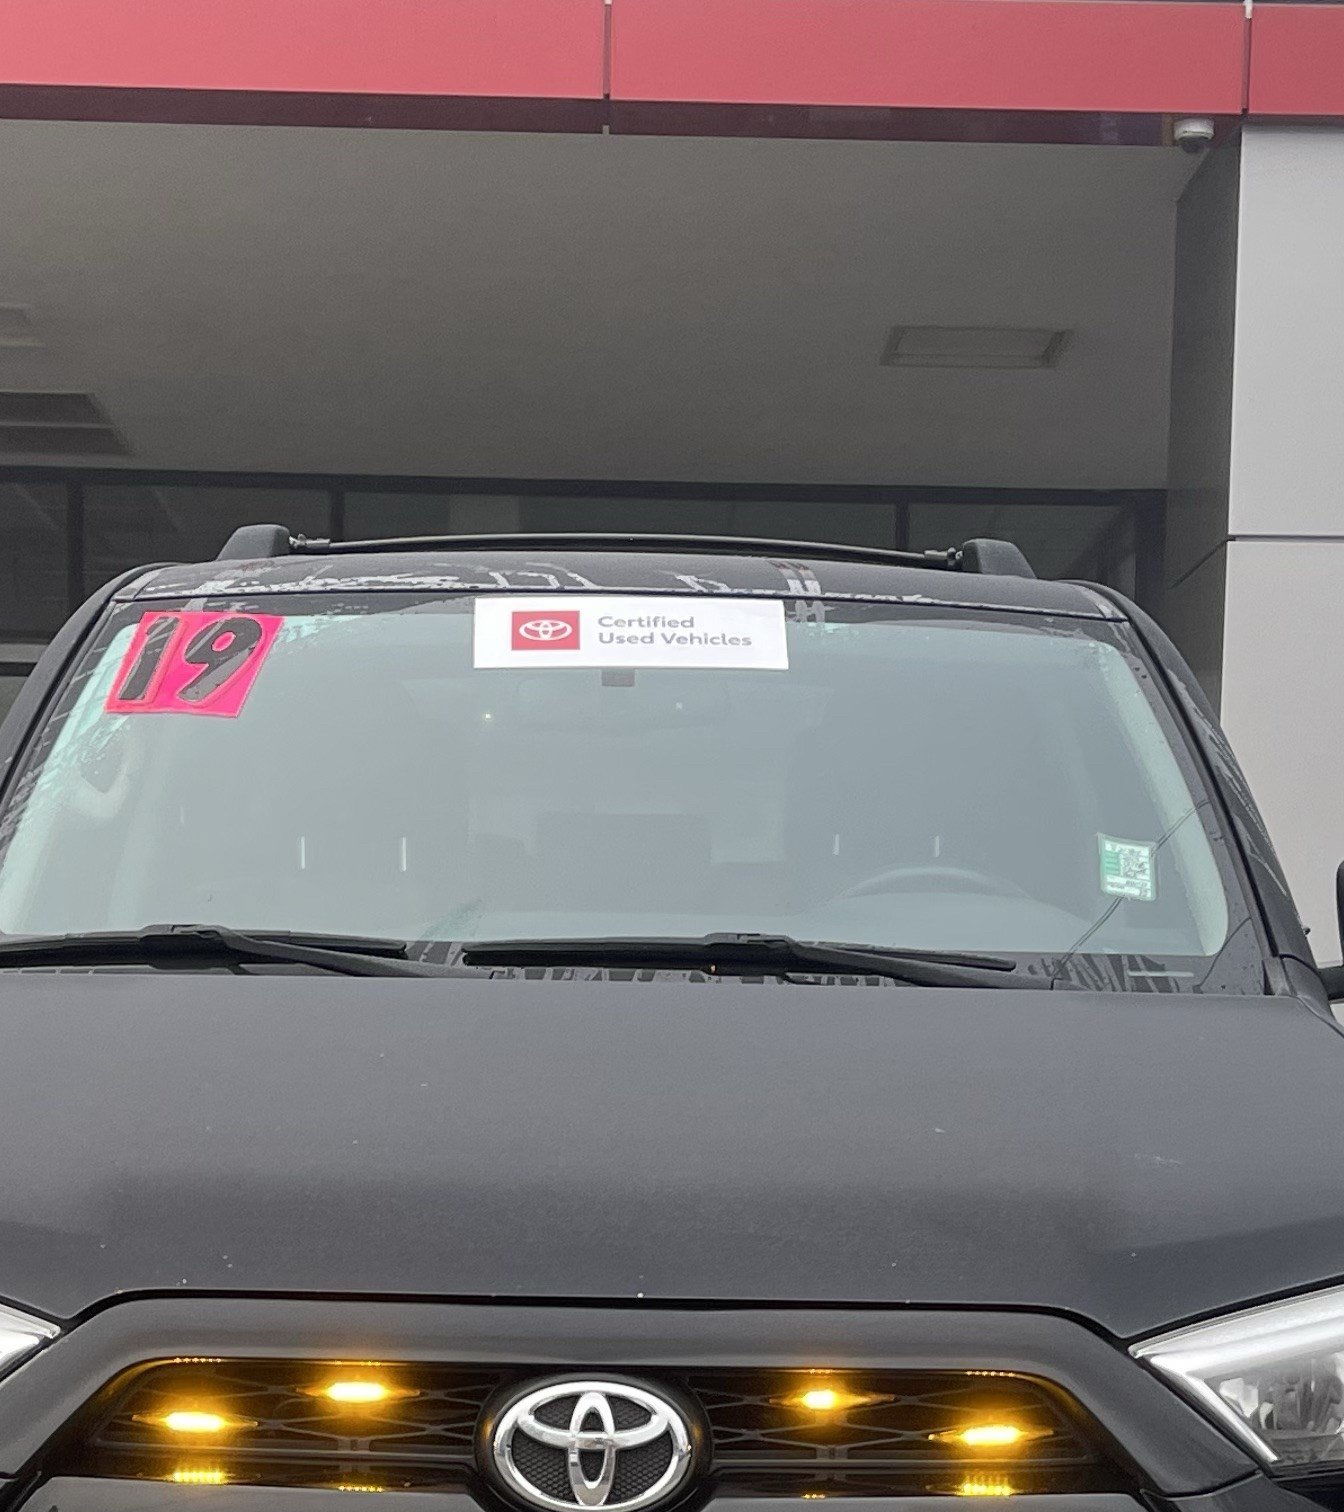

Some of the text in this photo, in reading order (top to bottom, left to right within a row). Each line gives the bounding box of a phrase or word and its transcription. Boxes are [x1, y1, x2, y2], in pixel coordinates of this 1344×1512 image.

[597, 615, 695, 629] Certified
[598, 631, 753, 647] Used Vehicles
[118, 615, 263, 703] 19
